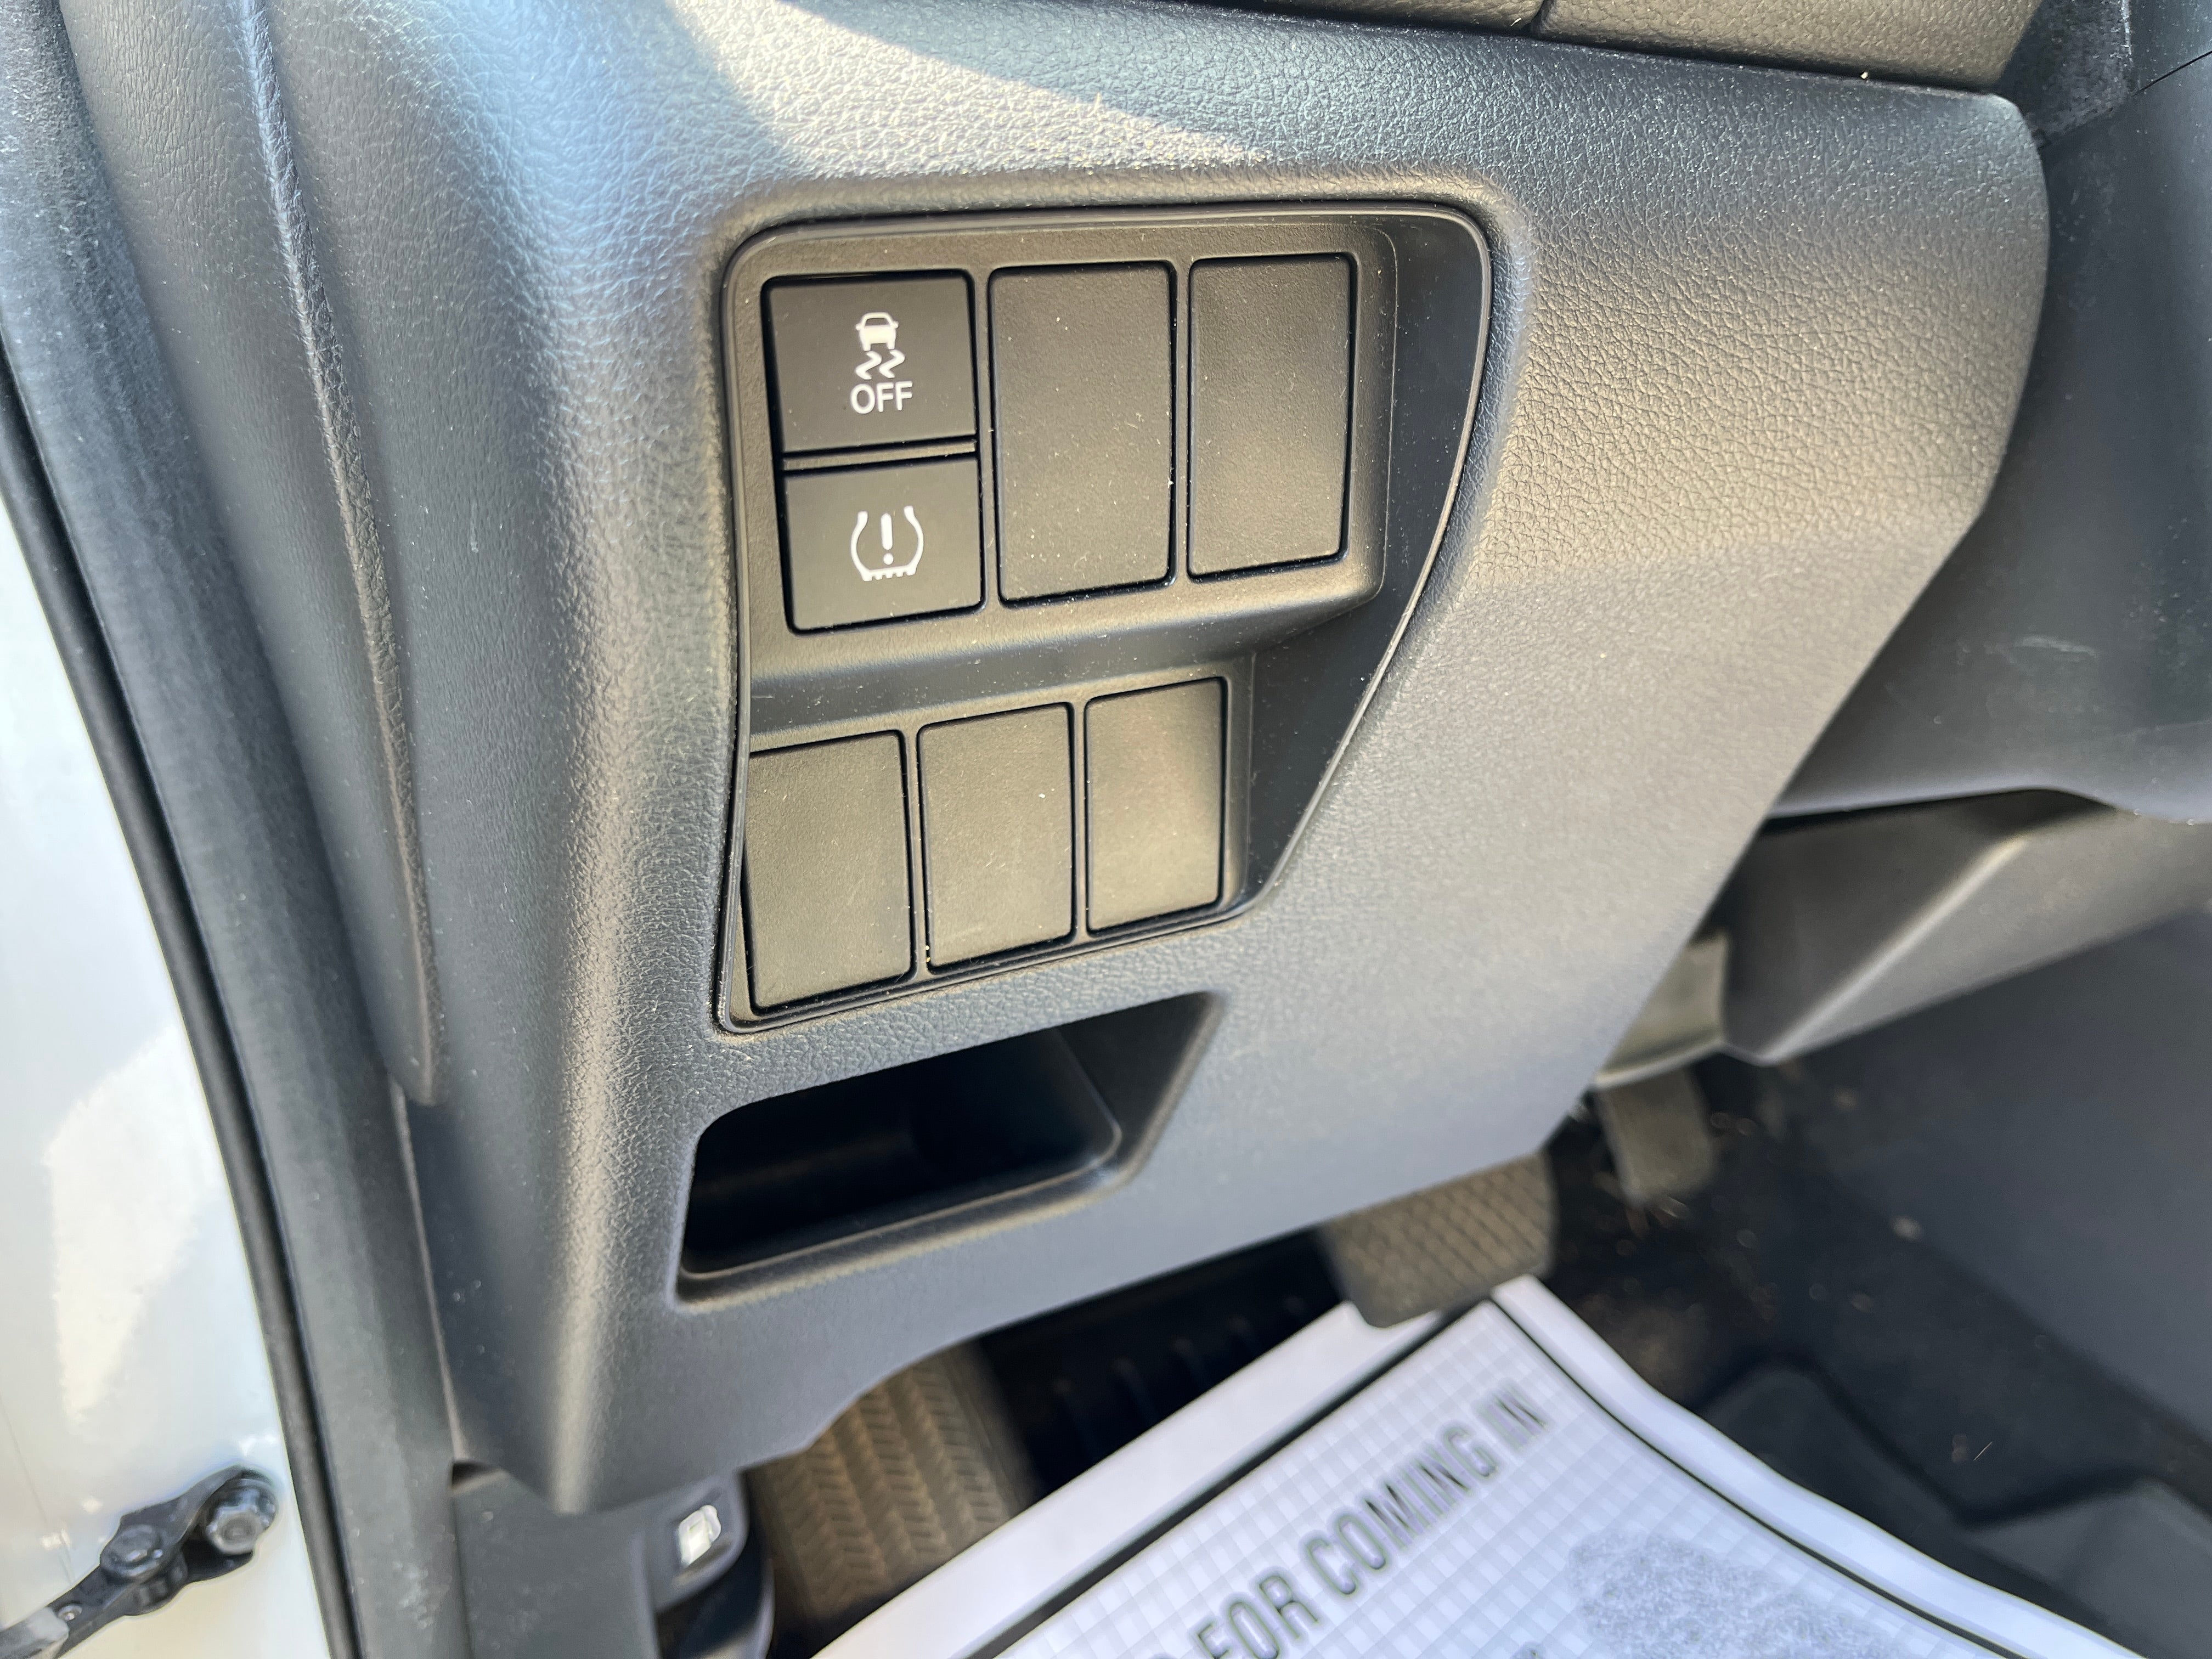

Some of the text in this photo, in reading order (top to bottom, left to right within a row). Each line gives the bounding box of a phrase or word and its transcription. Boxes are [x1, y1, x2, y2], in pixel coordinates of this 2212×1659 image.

[850, 380, 913, 414] OFF
[1301, 1422, 1500, 1598] COMING
[1479, 1384, 1549, 1453] IN
